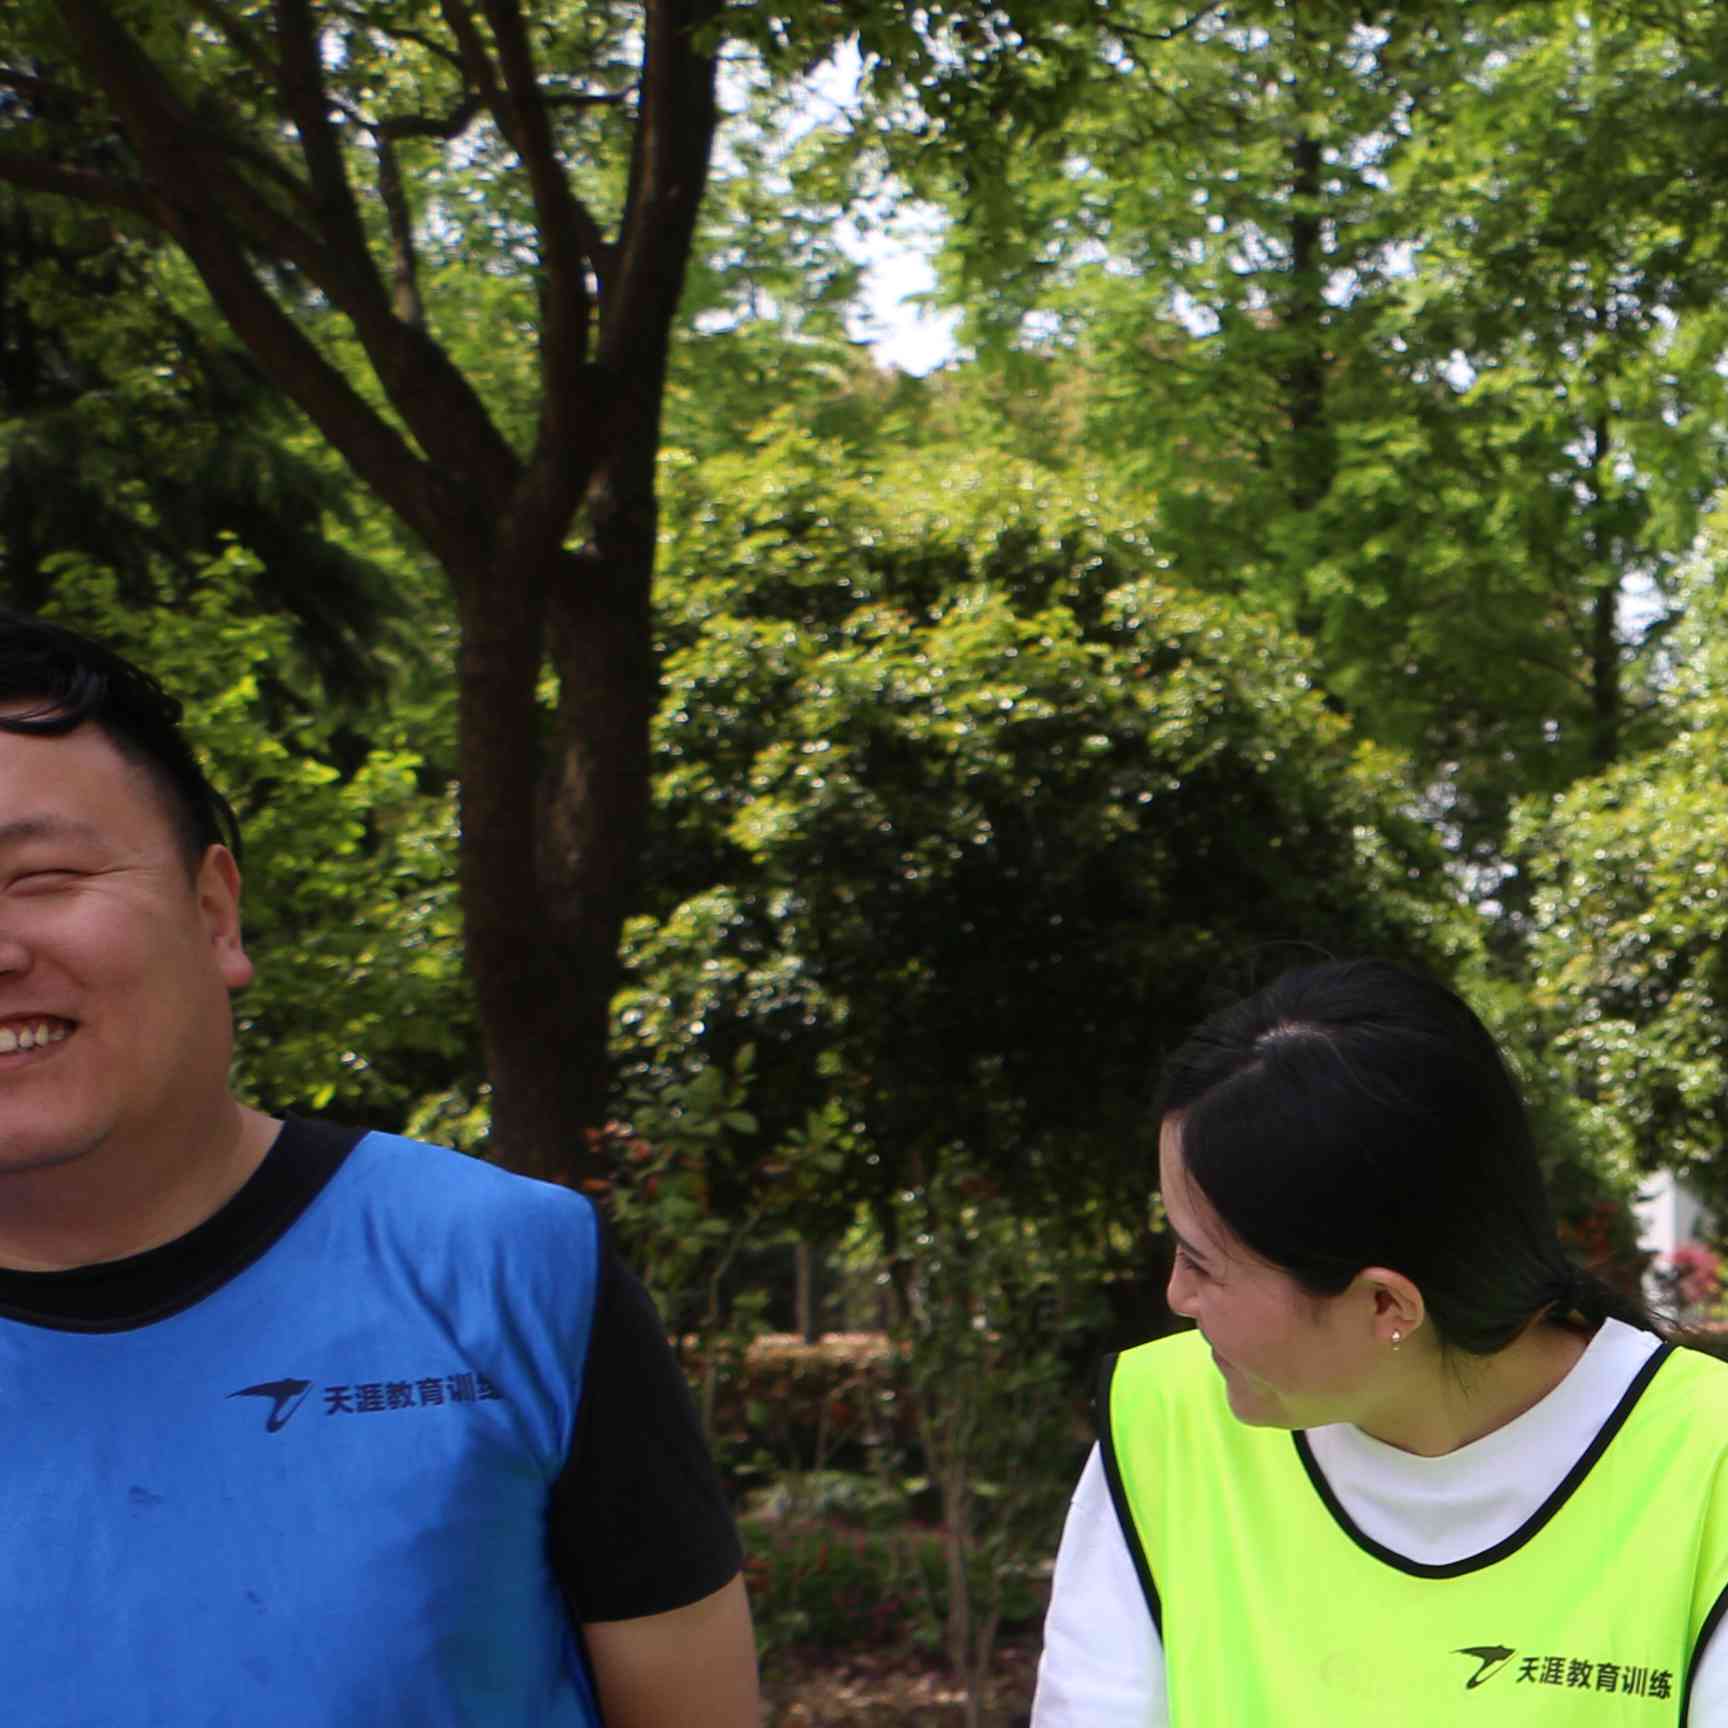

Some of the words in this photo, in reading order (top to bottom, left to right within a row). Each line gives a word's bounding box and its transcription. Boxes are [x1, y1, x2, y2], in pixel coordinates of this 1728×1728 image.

[1516, 1656, 1674, 1699] 天涯教育训练
